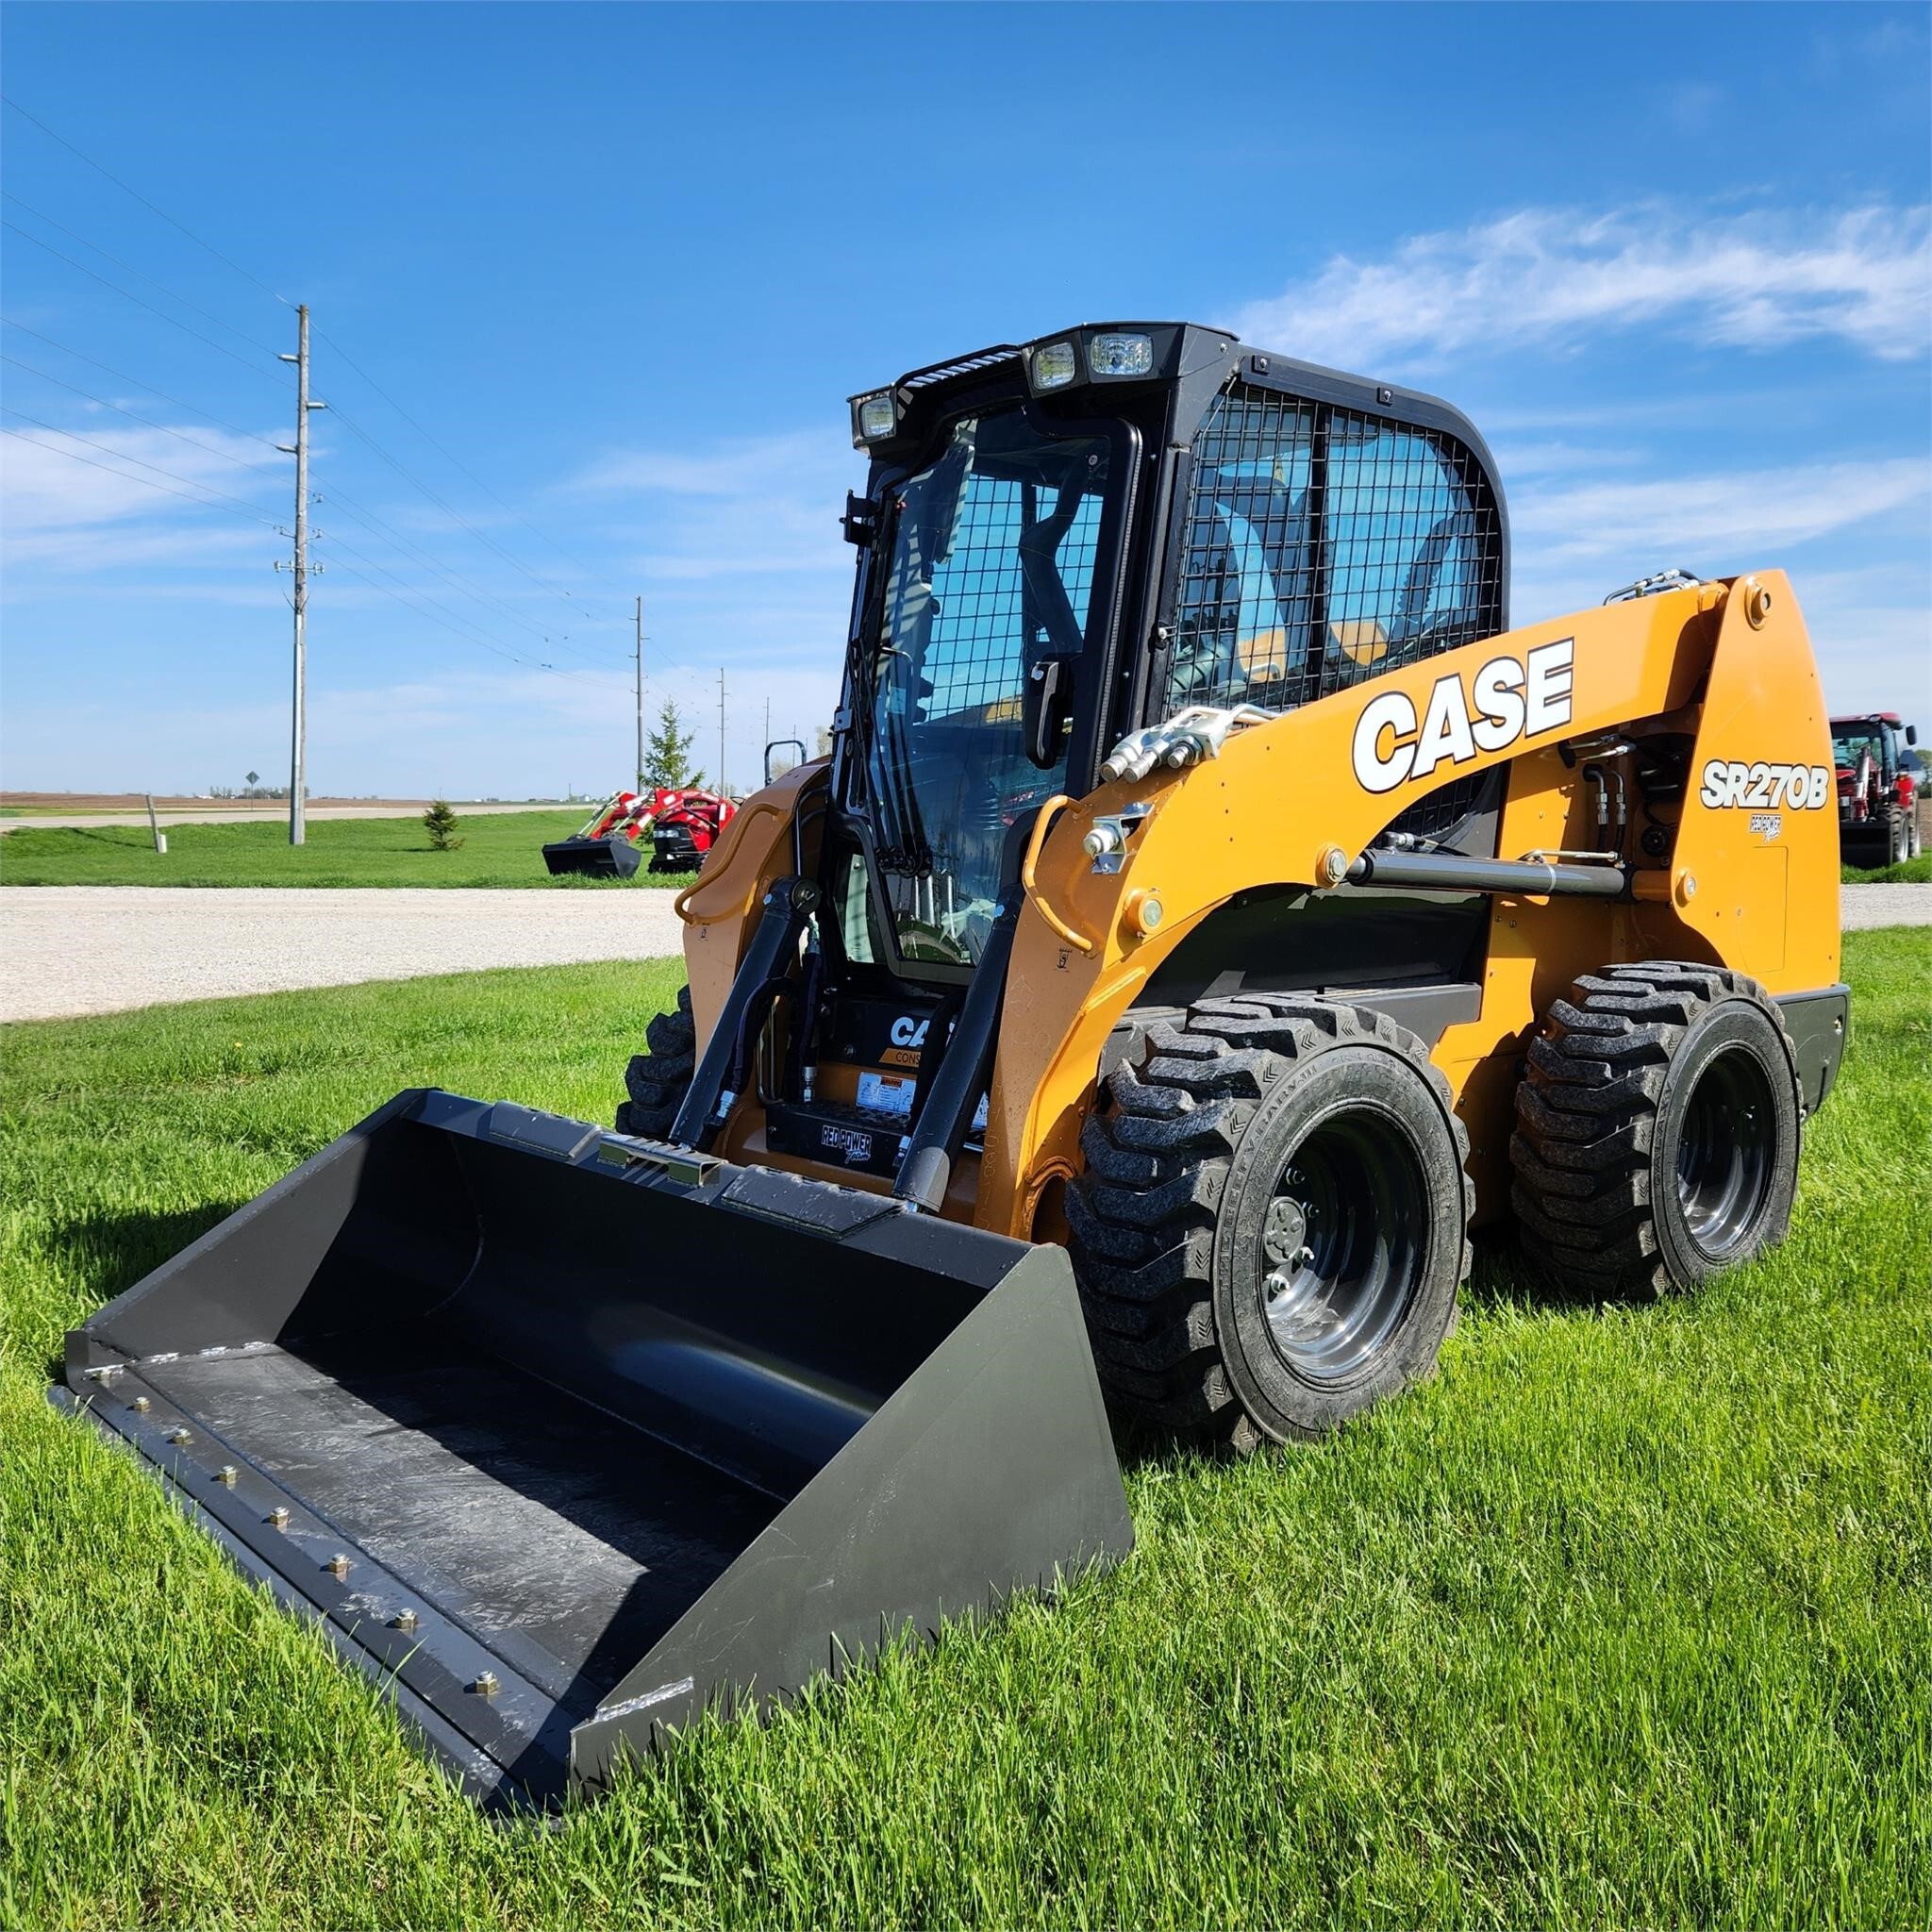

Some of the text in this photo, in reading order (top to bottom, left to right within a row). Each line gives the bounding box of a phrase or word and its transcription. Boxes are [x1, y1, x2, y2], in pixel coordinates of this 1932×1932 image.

[1352, 637, 1574, 794] CASE
[1700, 759, 1830, 810] SR270B
[891, 1016, 930, 1047] CA
[895, 1052, 921, 1065] CONS
[822, 1124, 872, 1155] RED POWER
[844, 1151, 872, 1164] Team
